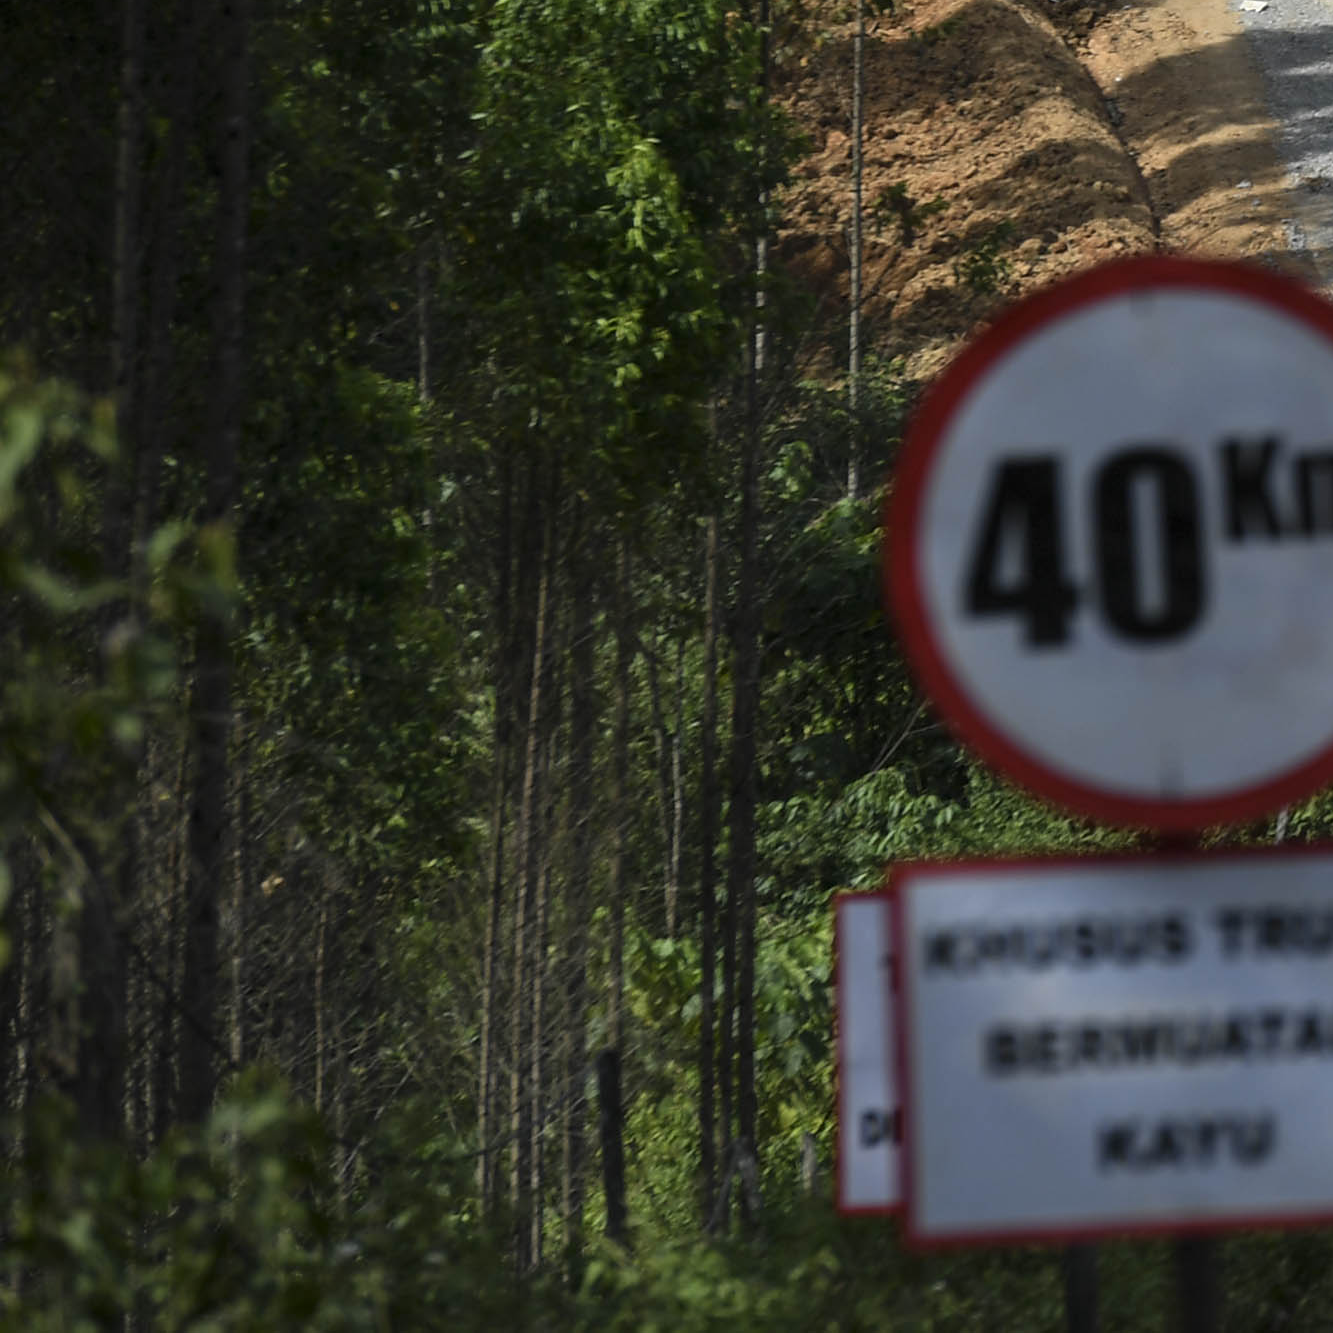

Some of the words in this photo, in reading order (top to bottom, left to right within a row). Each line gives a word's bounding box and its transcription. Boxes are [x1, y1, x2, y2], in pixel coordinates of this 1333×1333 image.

[961, 442, 1212, 652] 40
[925, 911, 1190, 974] KHUSUS
[1097, 1112, 1277, 1174] KAYU
